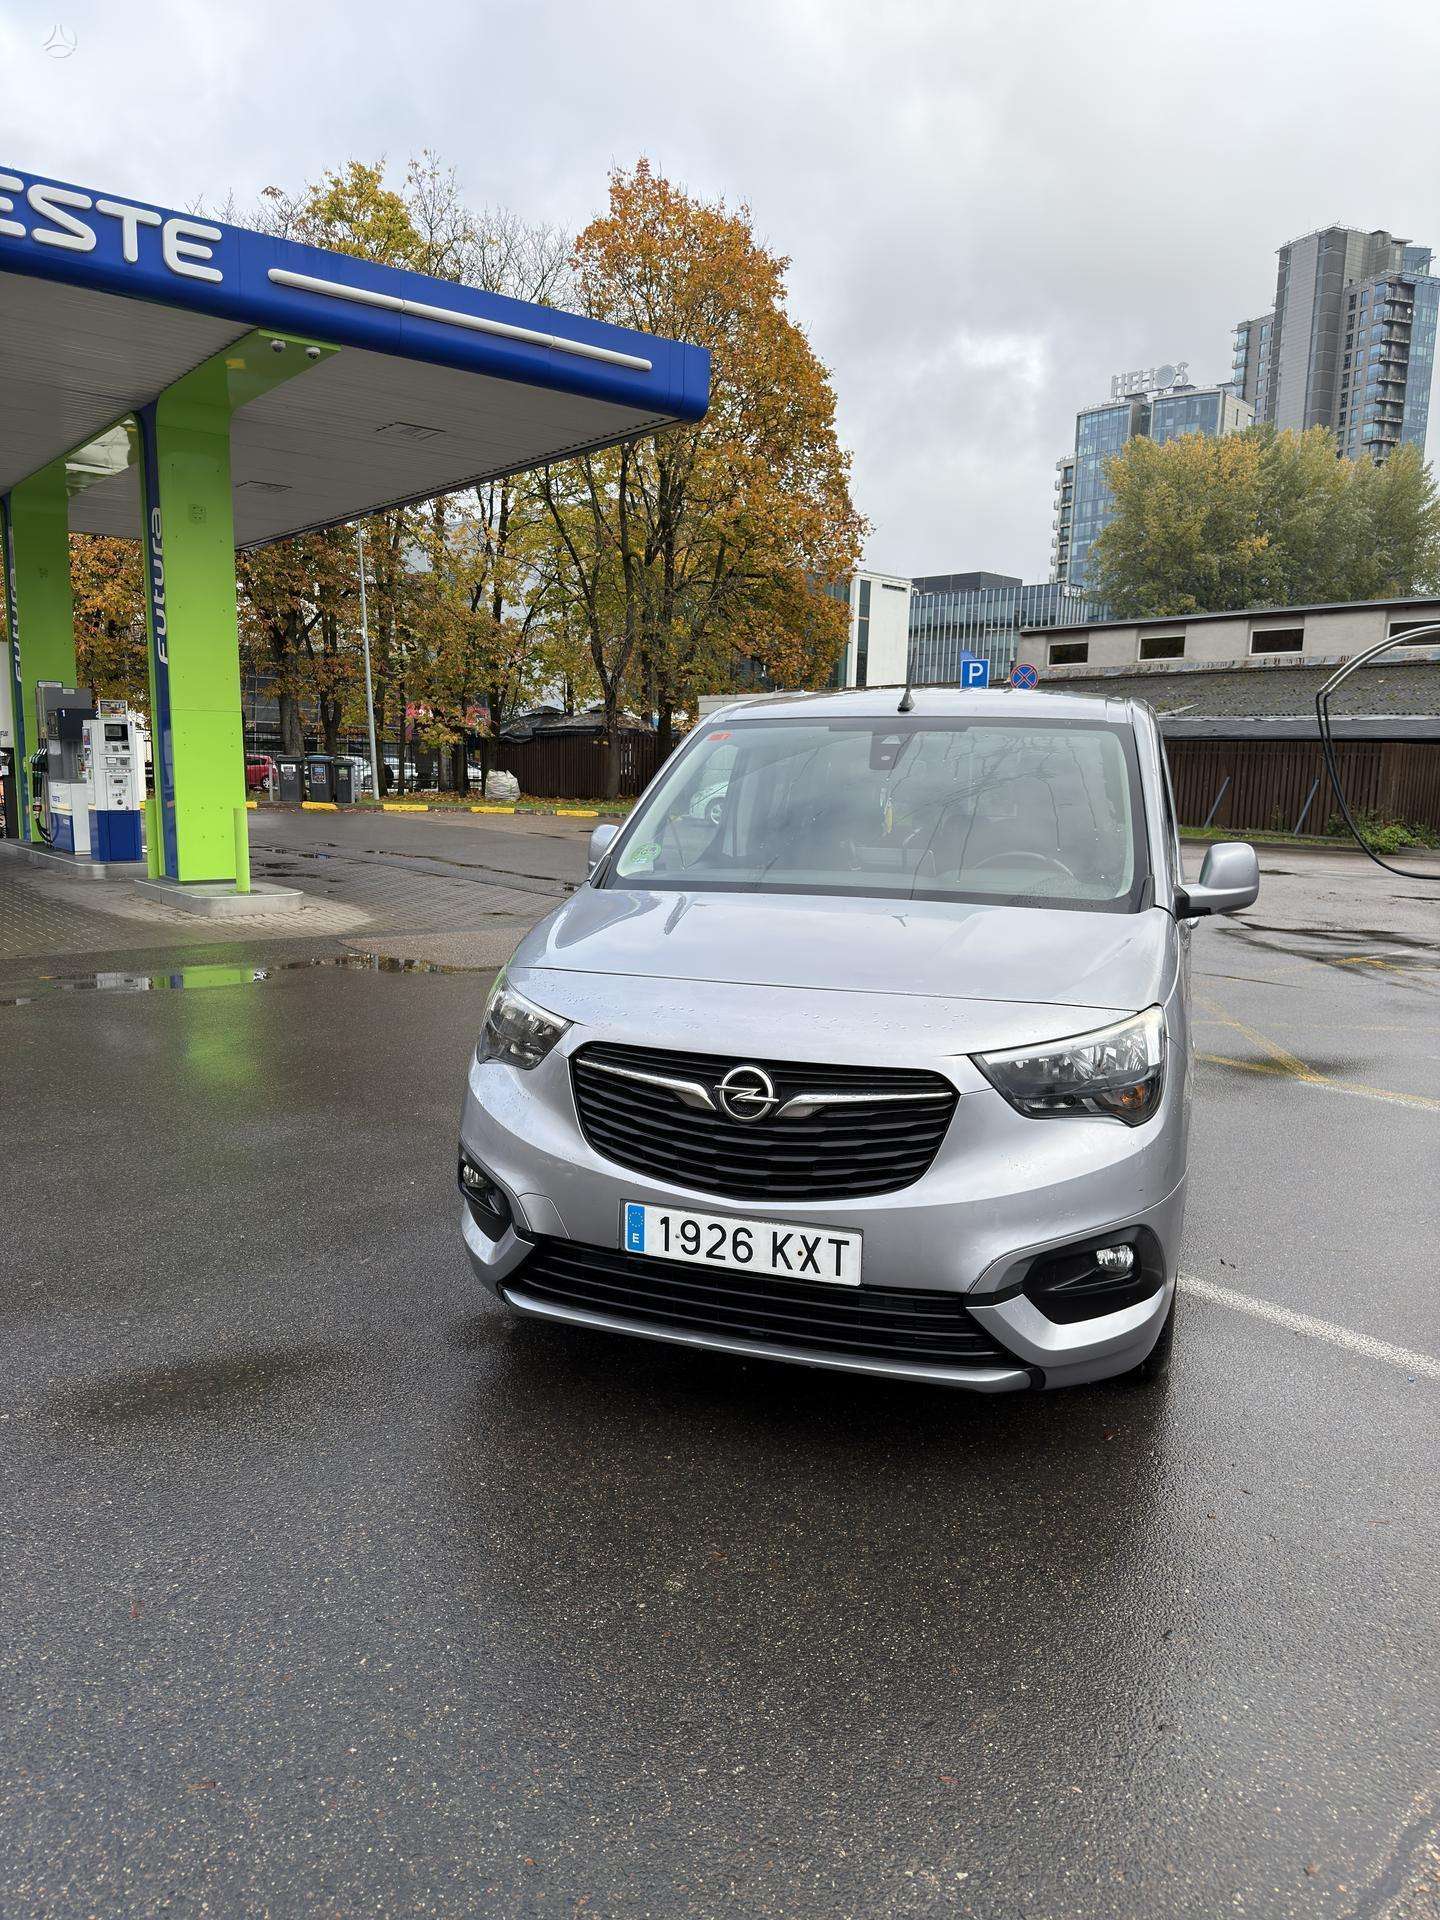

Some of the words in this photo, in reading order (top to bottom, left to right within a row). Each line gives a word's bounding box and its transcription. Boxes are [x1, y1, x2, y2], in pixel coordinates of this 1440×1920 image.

[151, 507, 169, 665] Futura
[968, 662, 984, 684] P
[632, 1232, 640, 1244] E
[659, 1216, 754, 1264] 1926
[771, 1231, 850, 1277] KXT
